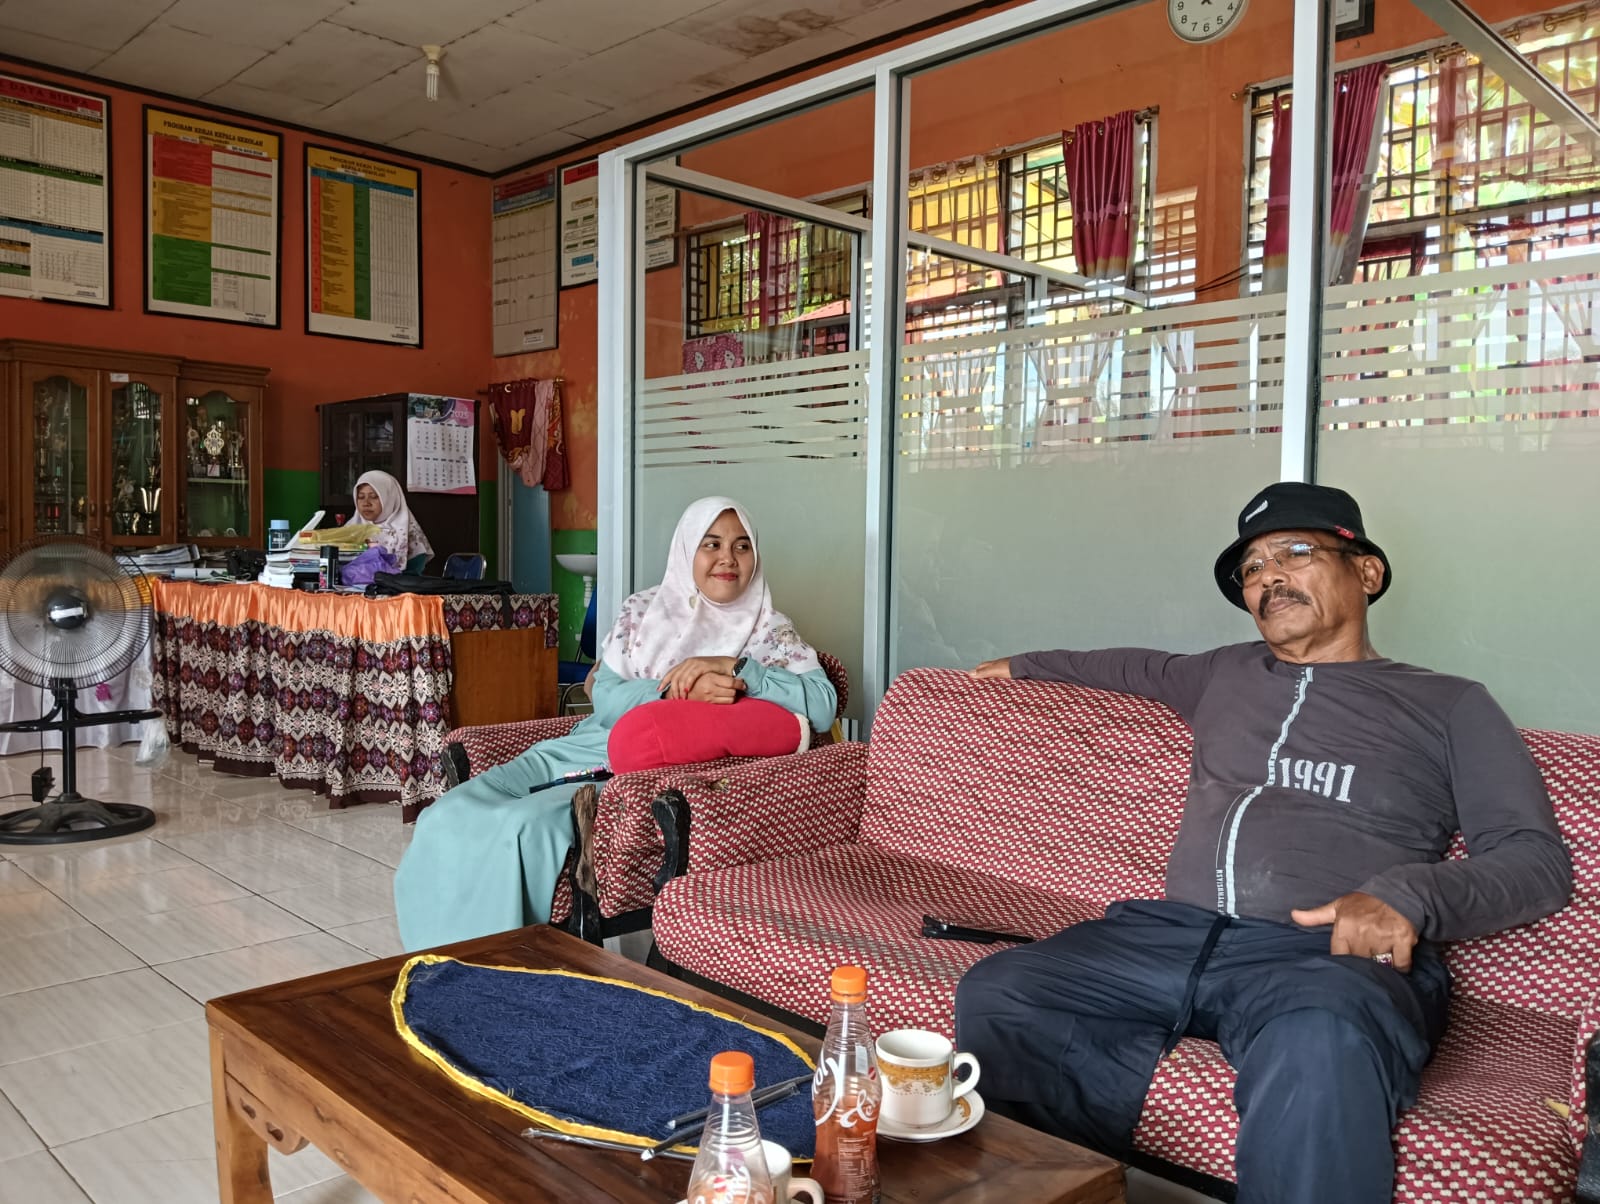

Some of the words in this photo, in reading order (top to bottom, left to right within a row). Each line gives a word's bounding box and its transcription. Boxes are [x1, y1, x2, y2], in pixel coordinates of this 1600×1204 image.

[1177, 1, 1184, 11] 9
[1227, 2, 1234, 11] 4
[1180, 14, 1188, 24] 8
[1216, 15, 1224, 25] 5
[1191, 21, 1198, 32] 7
[1203, 22, 1210, 33] 6
[163, 120, 193, 132] PROGRAM
[1279, 757, 1356, 803] 1991
